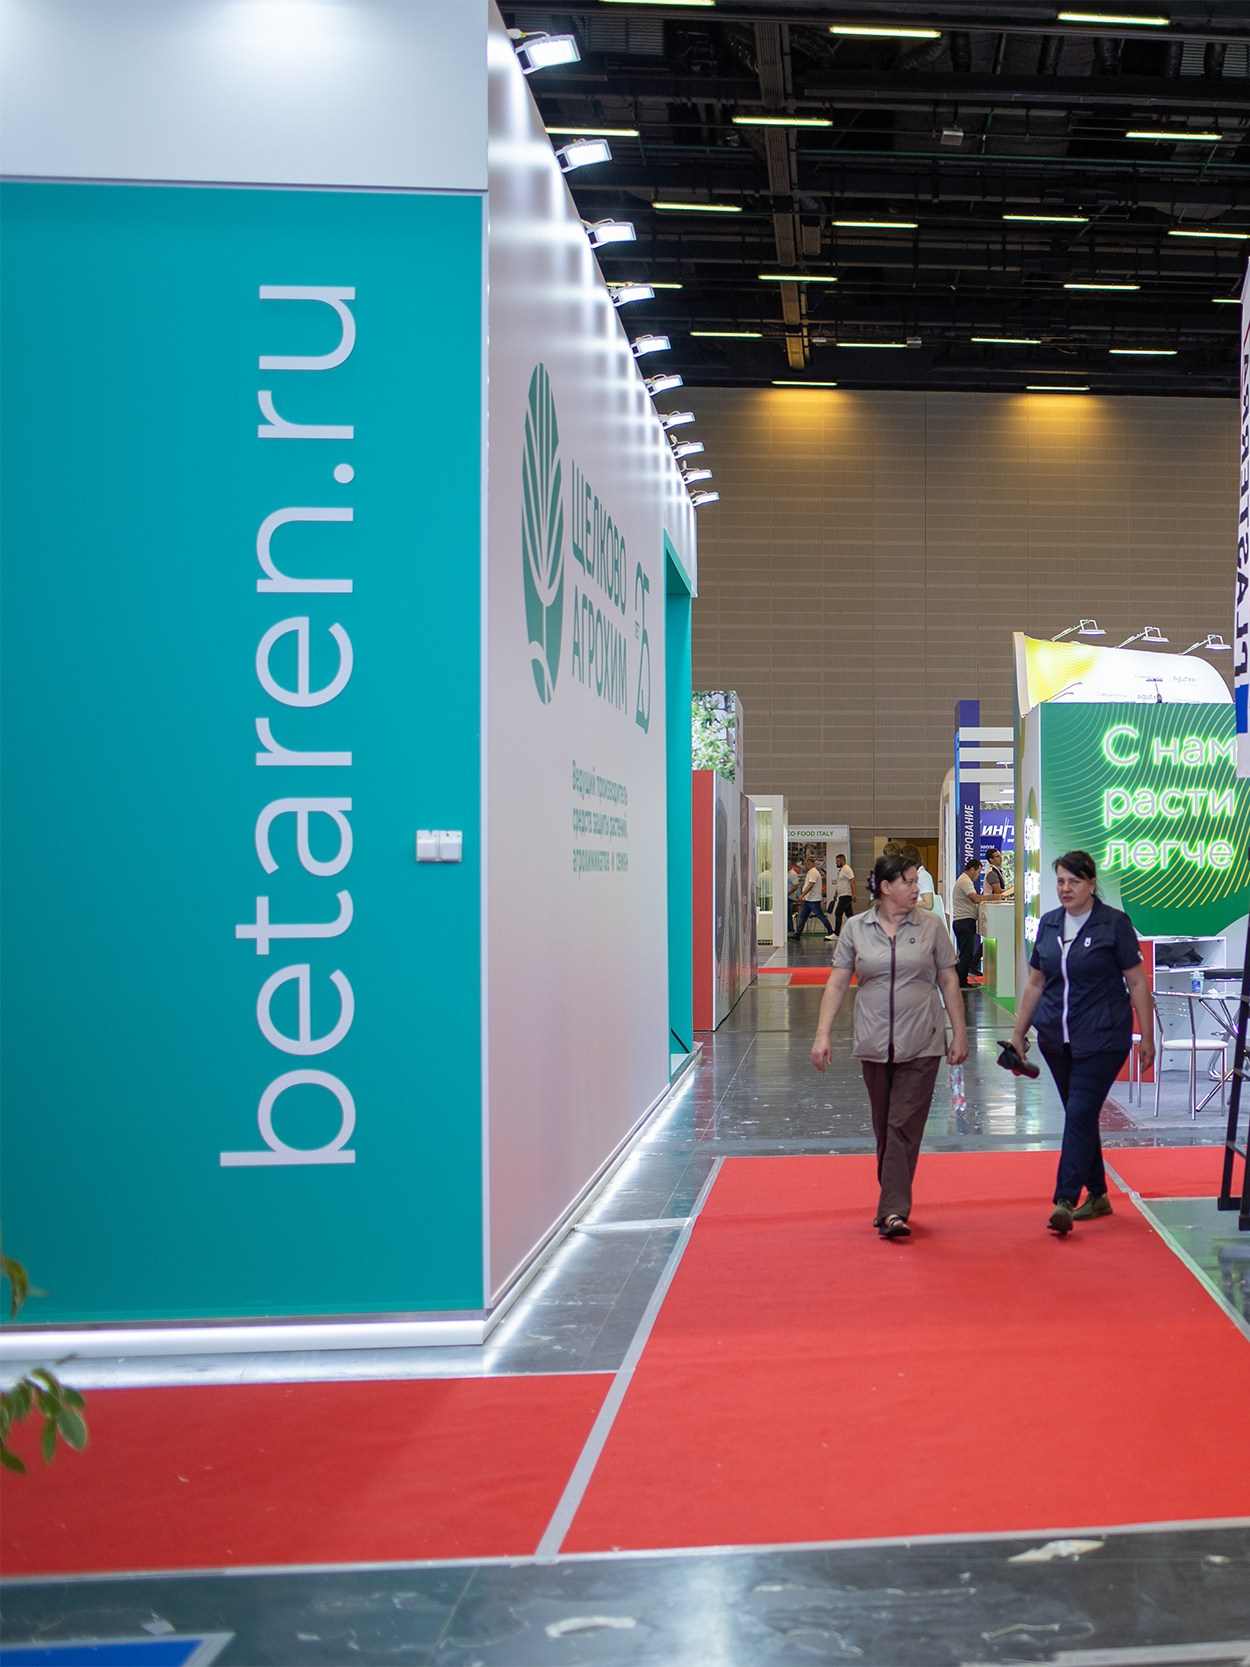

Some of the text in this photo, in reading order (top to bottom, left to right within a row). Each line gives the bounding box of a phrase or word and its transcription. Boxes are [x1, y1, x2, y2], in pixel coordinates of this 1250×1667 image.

[572, 459, 627, 616] ЩЕЛКОВО
[572, 584, 628, 716] АГРОХИМ
[220, 284, 357, 1168] betaren.ru
[1104, 725, 1238, 766] С нам
[964, 804, 974, 866] СИРОВАНИЕ
[1104, 788, 1236, 828] расти
[1101, 839, 1235, 869] легче
